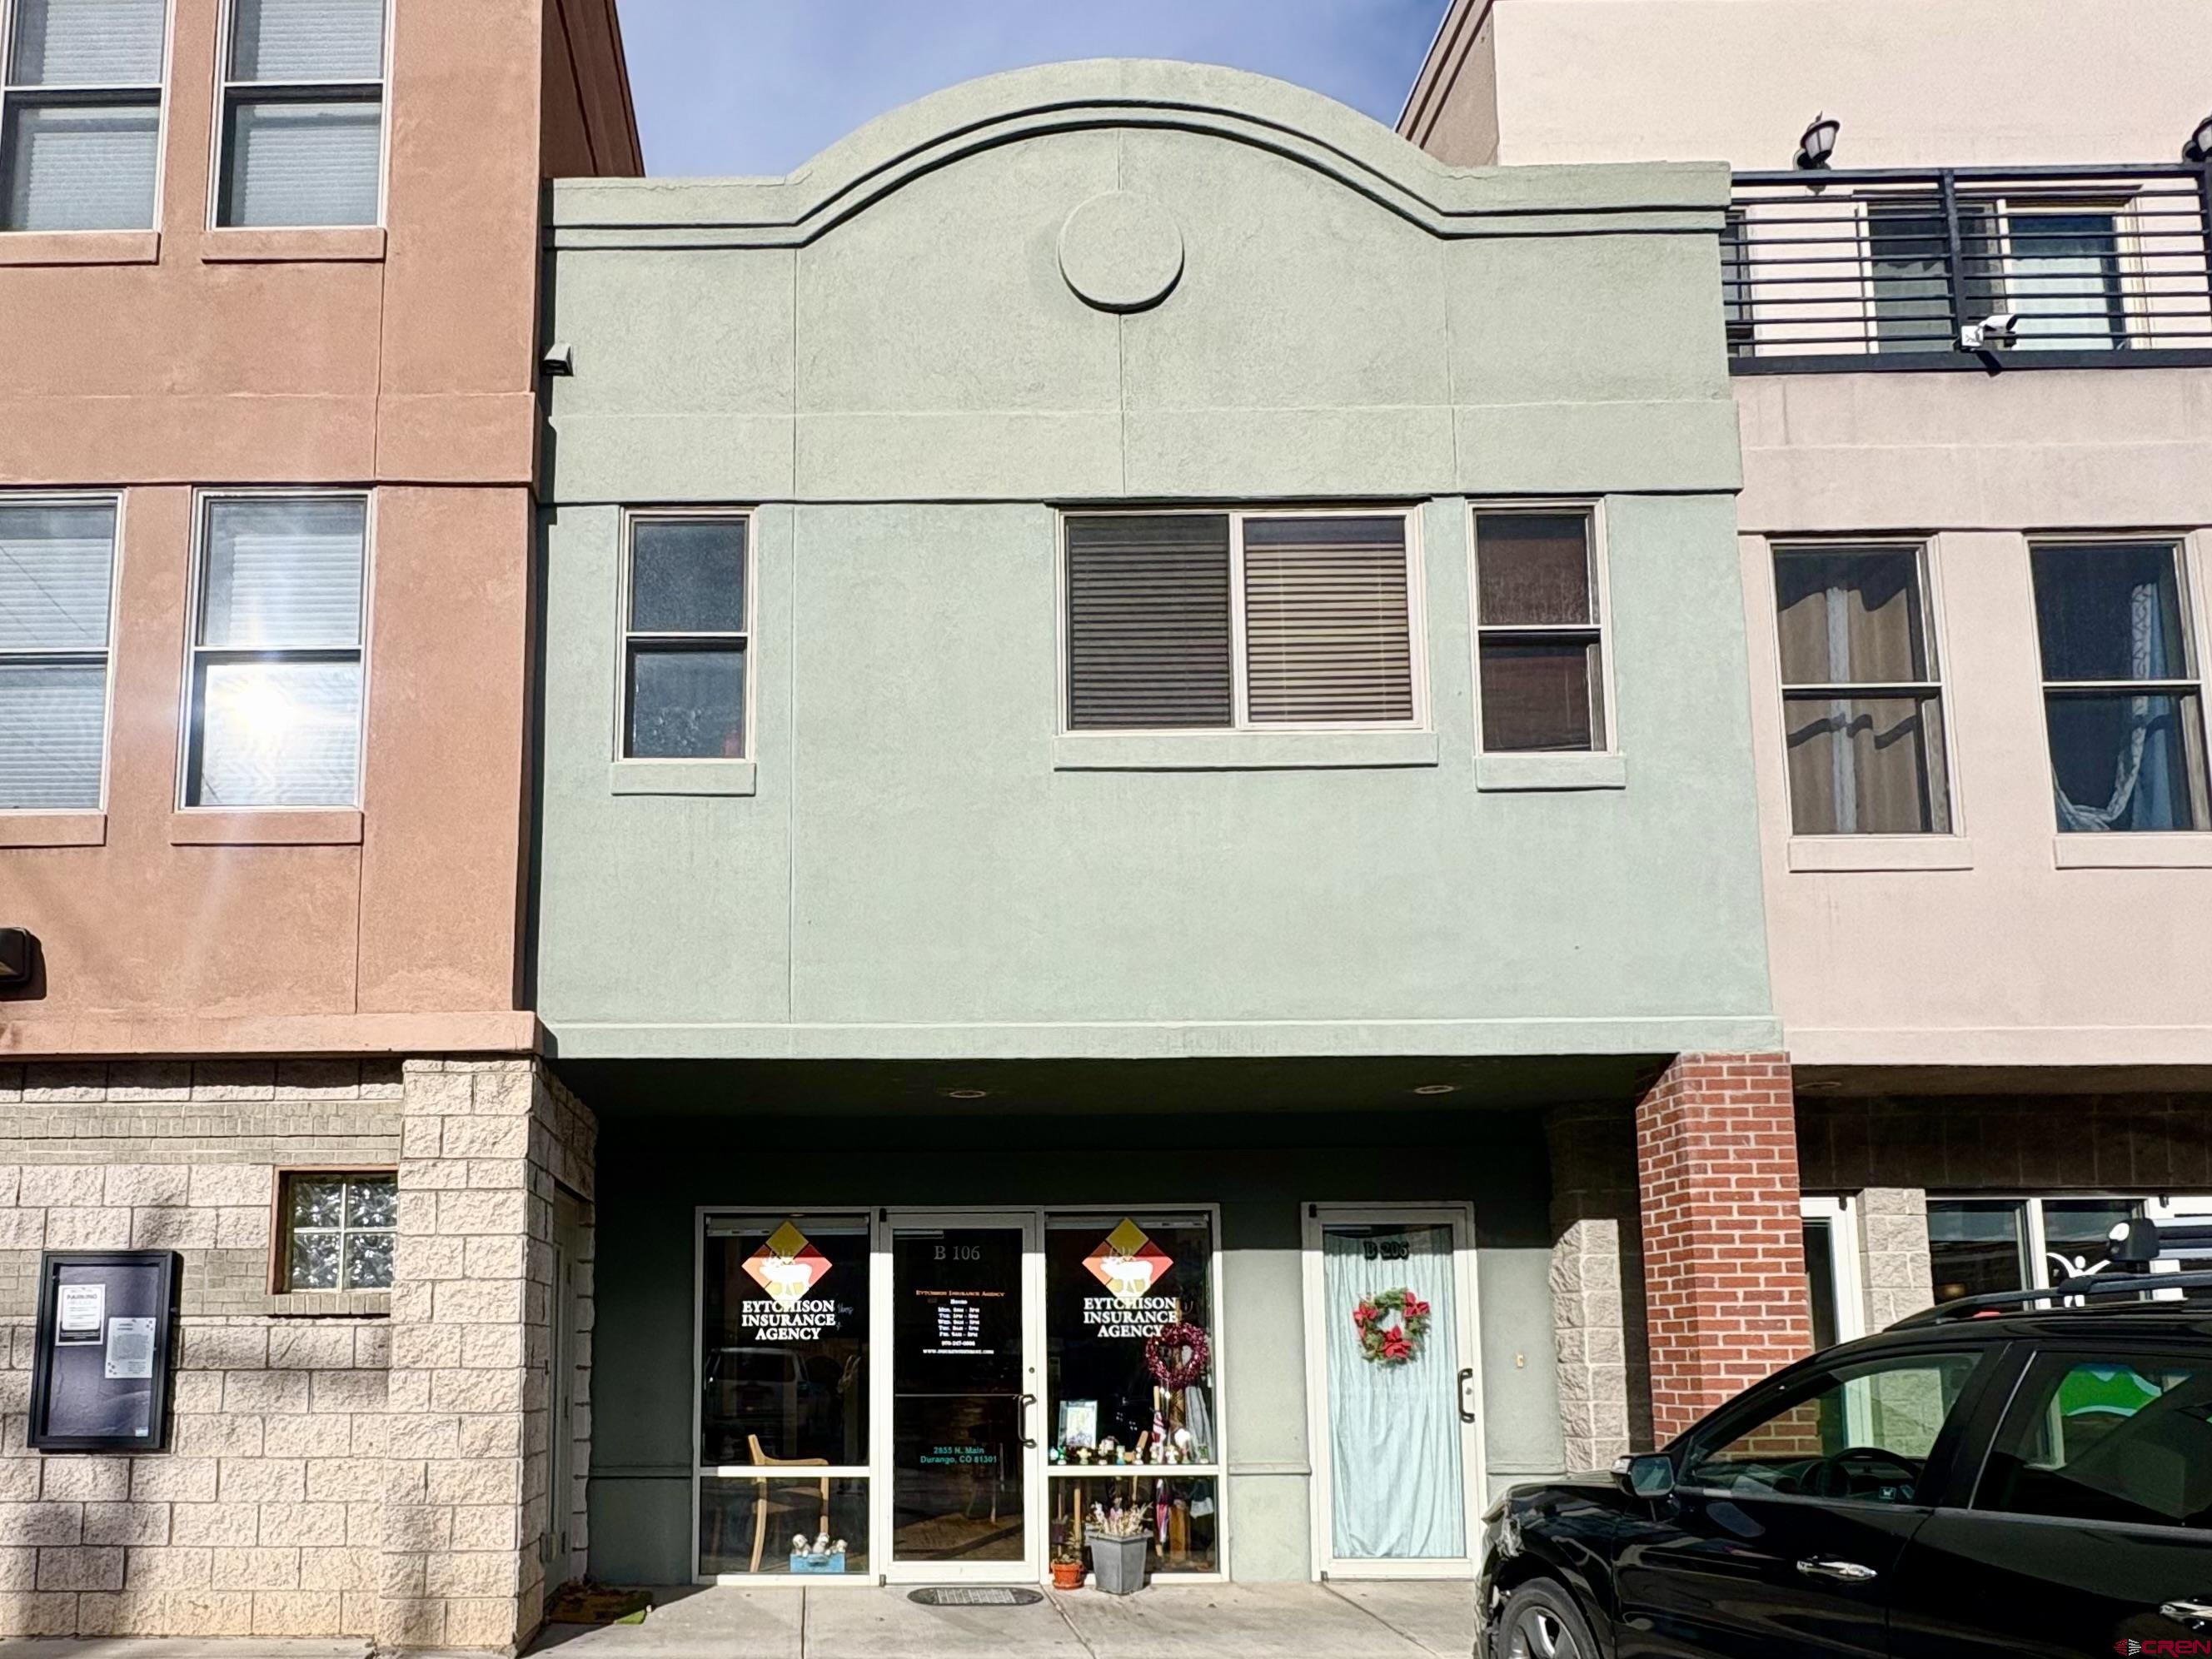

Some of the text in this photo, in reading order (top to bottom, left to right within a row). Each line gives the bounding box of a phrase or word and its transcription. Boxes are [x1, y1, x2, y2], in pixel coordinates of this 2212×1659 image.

[934, 1245, 980, 1260] B 106
[1363, 1241, 1409, 1260] B 206
[742, 1300, 834, 1313] EYTCHISON
[1084, 1298, 1176, 1310] EYTCHISON
[741, 1313, 836, 1327] INSURANCE
[1083, 1311, 1178, 1323] INSURANCE
[755, 1328, 821, 1340] AGENCY
[1097, 1325, 1163, 1338] AGENCY
[920, 1455, 956, 1464] Durango,
